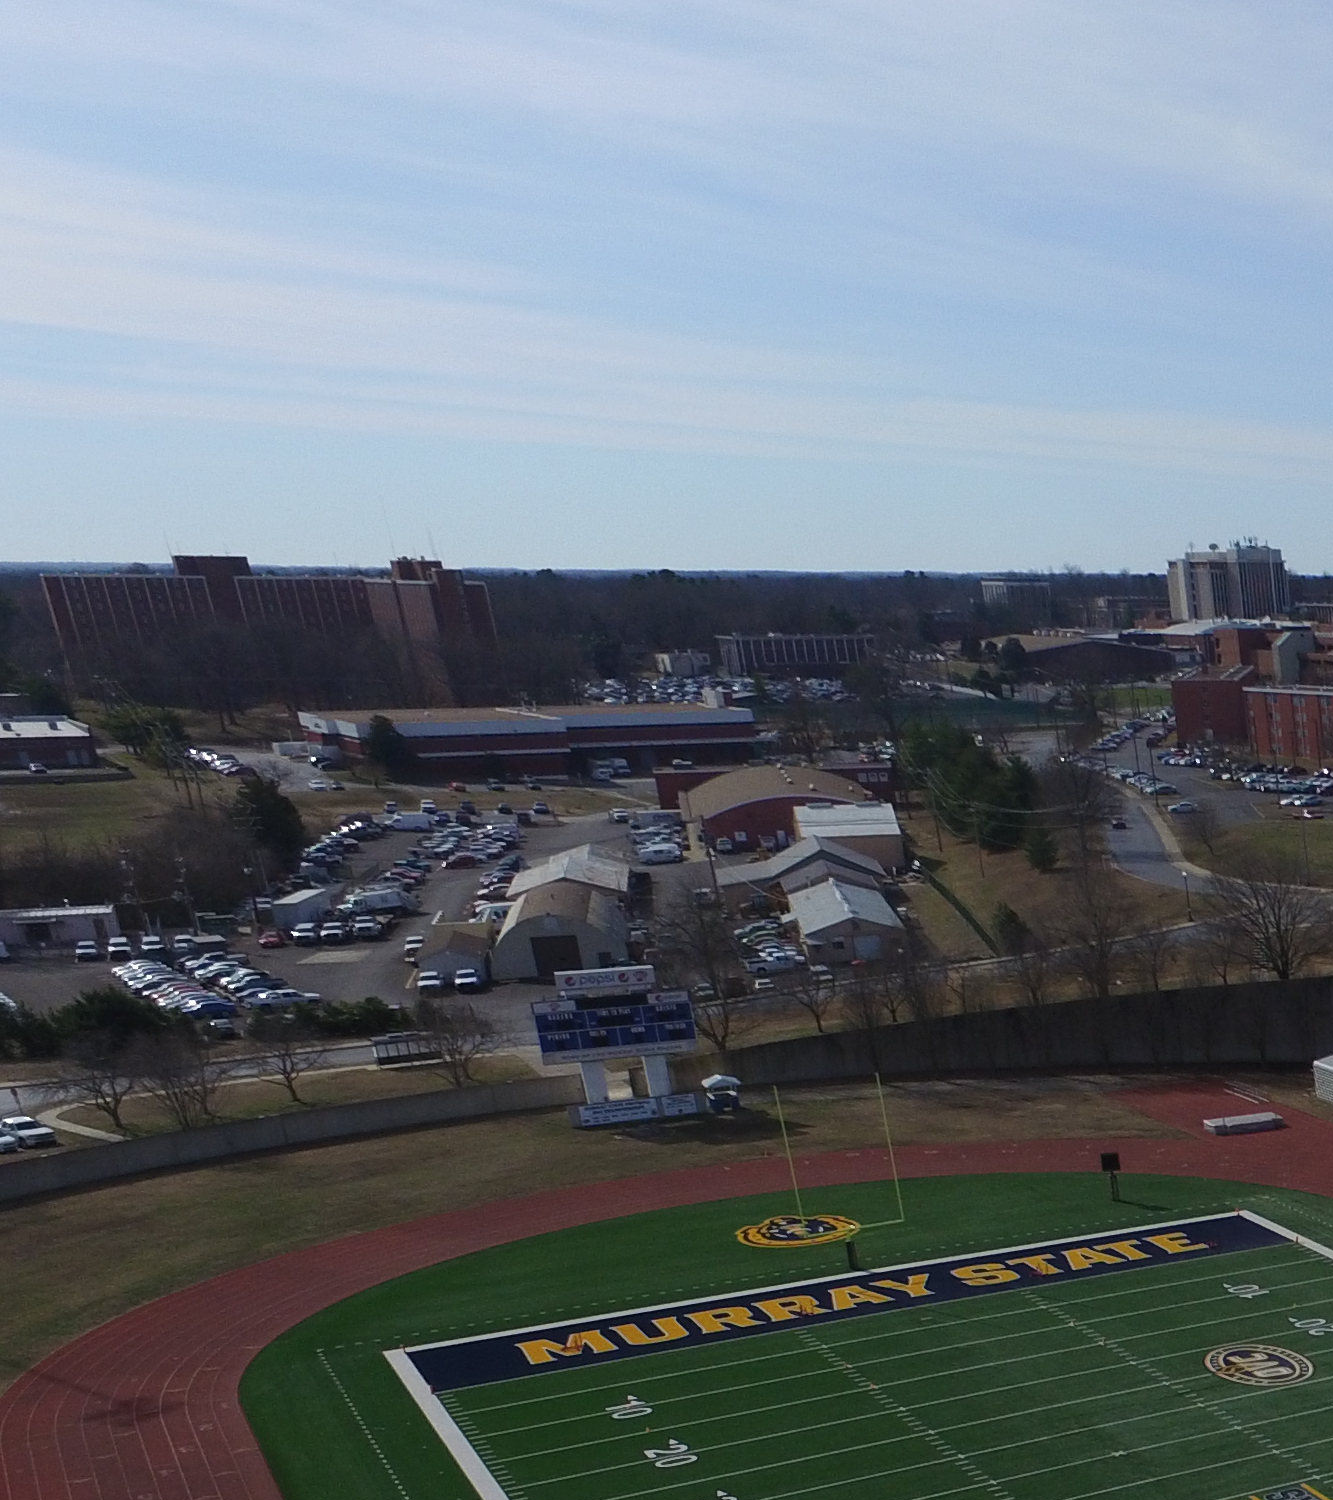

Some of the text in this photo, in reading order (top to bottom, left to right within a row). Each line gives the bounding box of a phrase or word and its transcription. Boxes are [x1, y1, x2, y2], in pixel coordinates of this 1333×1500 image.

[579, 972, 615, 987] pepsi
[513, 1231, 1209, 1366] MURRAY STATE
[1231, 1284, 1270, 1298] 10
[605, 1400, 653, 1420] 10
[643, 1443, 698, 1468] 20
